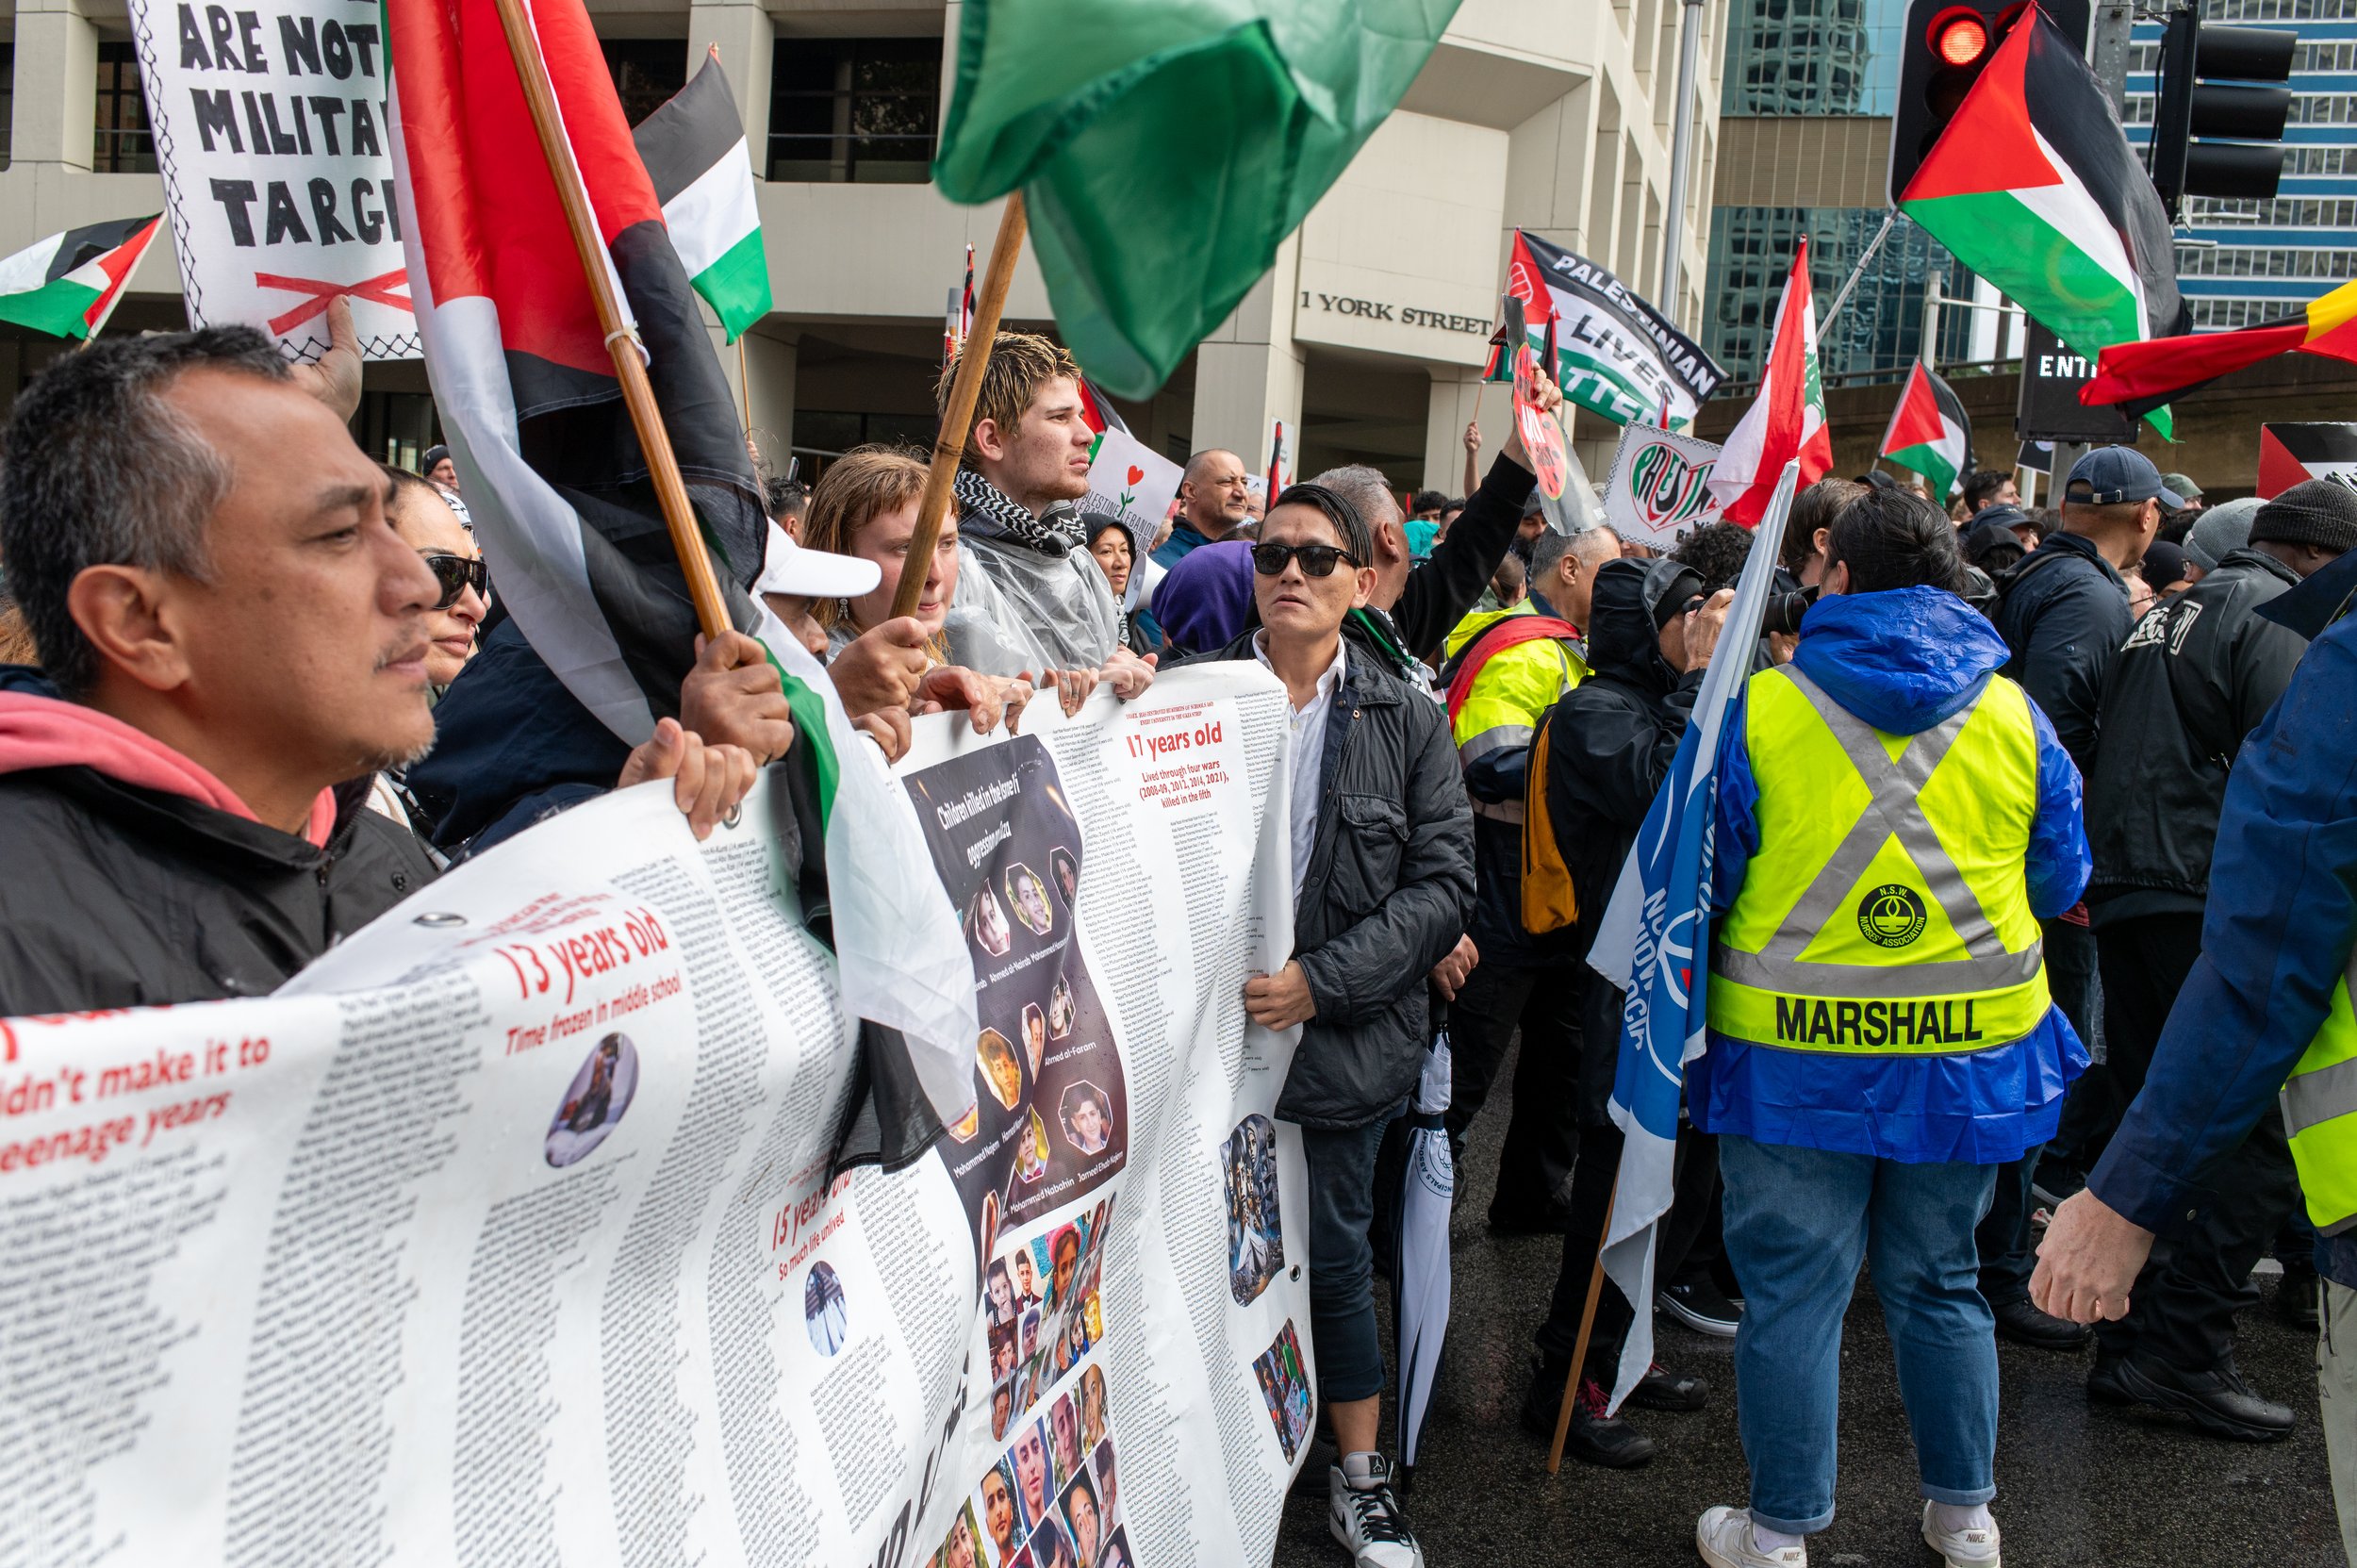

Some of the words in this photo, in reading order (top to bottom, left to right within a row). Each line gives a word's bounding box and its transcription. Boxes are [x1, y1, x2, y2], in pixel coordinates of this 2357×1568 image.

[177, 3, 269, 74] ARE
[276, 15, 380, 80] NOT
[190, 88, 391, 157] MILITA
[1301, 291, 1310, 308] 1
[1318, 293, 1394, 322] YORK
[1401, 307, 1493, 336] STREET
[1571, 314, 1675, 405] LIVES
[2039, 355, 2098, 378] ENT
[1081, 490, 1121, 519] ALESTINE
[1120, 509, 1158, 539] LEBANON
[1126, 734, 1144, 757] 17
[1146, 732, 1190, 762] years
[1195, 720, 1222, 746] old
[1142, 770, 1159, 783] Lived
[1160, 766, 1186, 778] through
[1187, 764, 1200, 774] four
[1201, 760, 1220, 771] wars
[937, 801, 968, 831] Children
[964, 788, 983, 817] killed
[1161, 795, 1181, 809] killed
[1181, 795, 1188, 804] in
[1188, 792, 1198, 802] the
[1198, 788, 1211, 800] fifth
[1879, 886, 1907, 898] N.S.W.
[1030, 942, 1056, 963] Mohammed
[1882, 916, 1925, 947] ASSOCIATION
[492, 944, 550, 999] 13
[547, 927, 631, 1005] years
[624, 906, 668, 957] old
[989, 966, 1011, 983] Ahmed
[505, 1024, 546, 1056] Time
[550, 1009, 593, 1042] frozen
[596, 999, 608, 1024] in
[610, 983, 649, 1018] middle
[651, 969, 683, 1003] school
[1775, 996, 1983, 1047] MARSHALL
[97, 1048, 195, 1099] make
[205, 1039, 228, 1077] it
[239, 1036, 271, 1068] to
[1045, 1055, 1063, 1067] Ahmed
[140, 1090, 232, 1148] years
[953, 1148, 986, 1180] Mohammed
[1077, 1166, 1099, 1183] Jameel
[1010, 1188, 1045, 1215] Mohammed
[1044, 1178, 1075, 1198] Nabahin
[772, 1203, 791, 1252] 15
[789, 1242, 808, 1273] much
[810, 1231, 820, 1252] life
[821, 1207, 845, 1241] unlived
[1782, 1551, 1801, 1562] NIKE
[1966, 1532, 1986, 1543] NIKE
